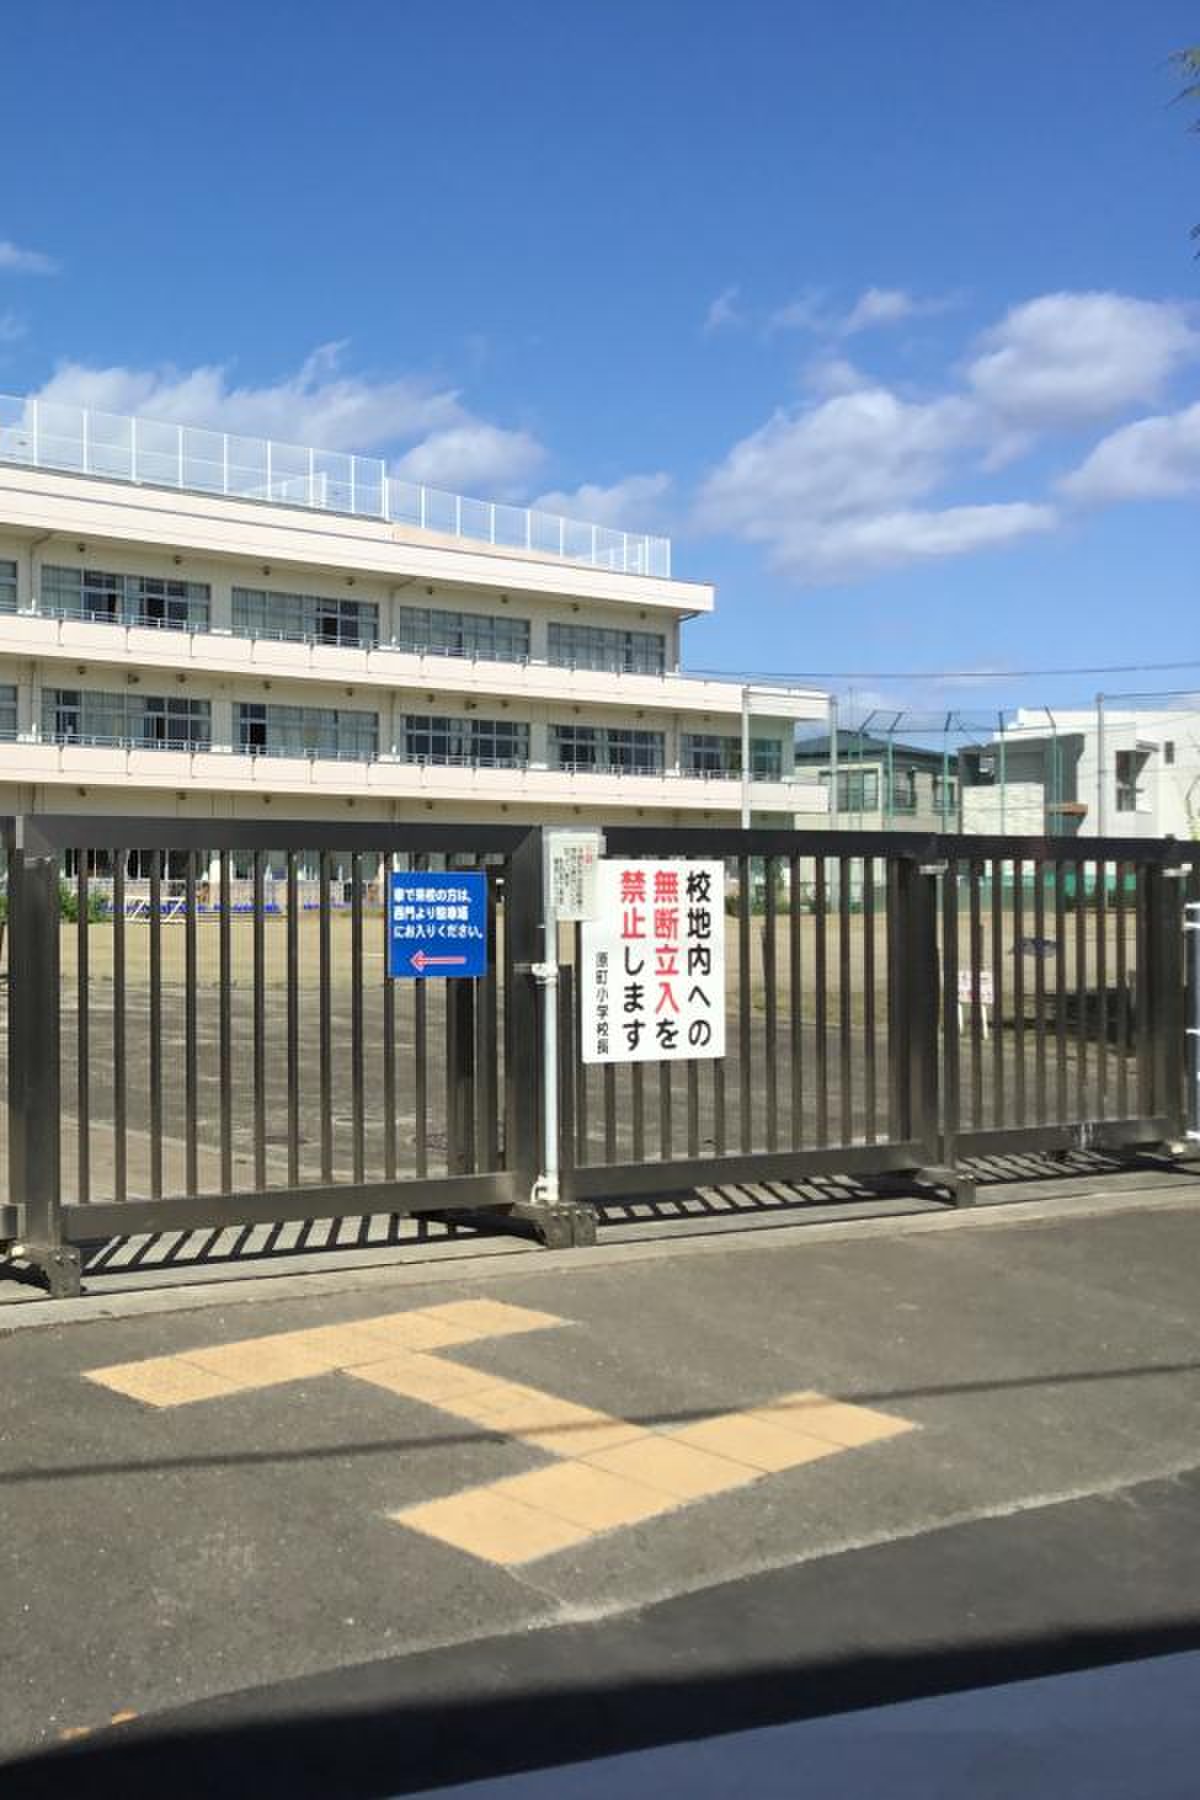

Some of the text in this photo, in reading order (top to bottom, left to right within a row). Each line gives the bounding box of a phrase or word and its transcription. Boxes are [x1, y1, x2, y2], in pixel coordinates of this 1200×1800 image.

[393, 923, 483, 939] にお入りください。
[620, 870, 646, 1052] 禁止します
[653, 869, 680, 1050] 無断立入を
[685, 869, 712, 1047] 校地内への
